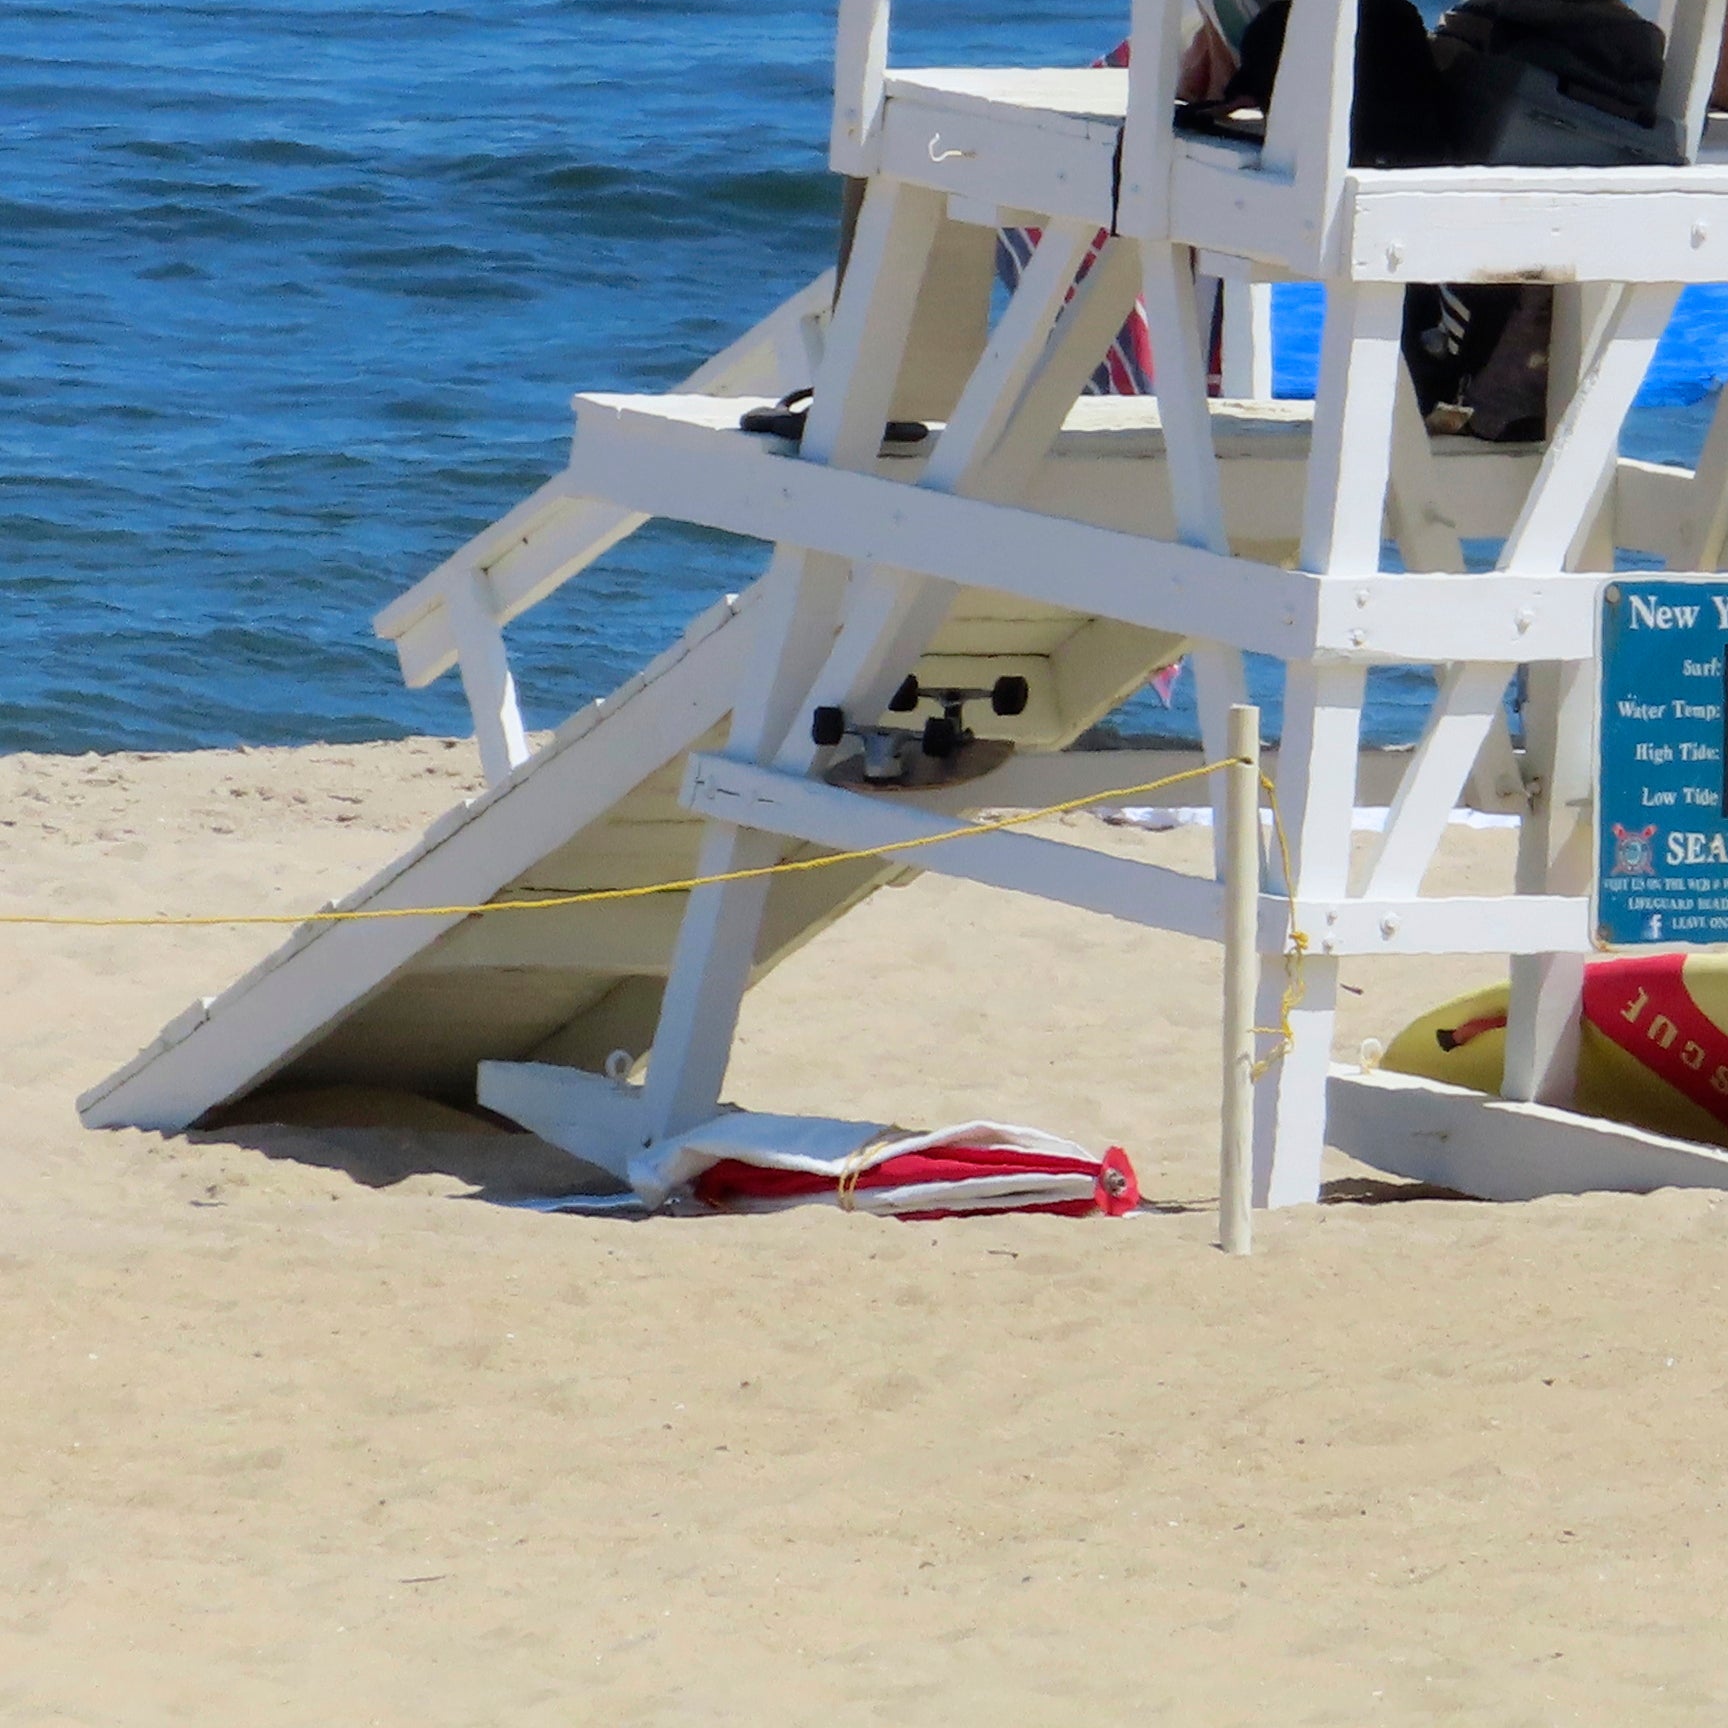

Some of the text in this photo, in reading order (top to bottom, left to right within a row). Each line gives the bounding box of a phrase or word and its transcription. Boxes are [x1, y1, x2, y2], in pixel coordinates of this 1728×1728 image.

[1628, 594, 1700, 630] New
[1682, 656, 1722, 677] Surf:
[1617, 699, 1721, 722] Water Temp:
[1634, 742, 1720, 766] High Tide:
[1641, 786, 1678, 807] Low
